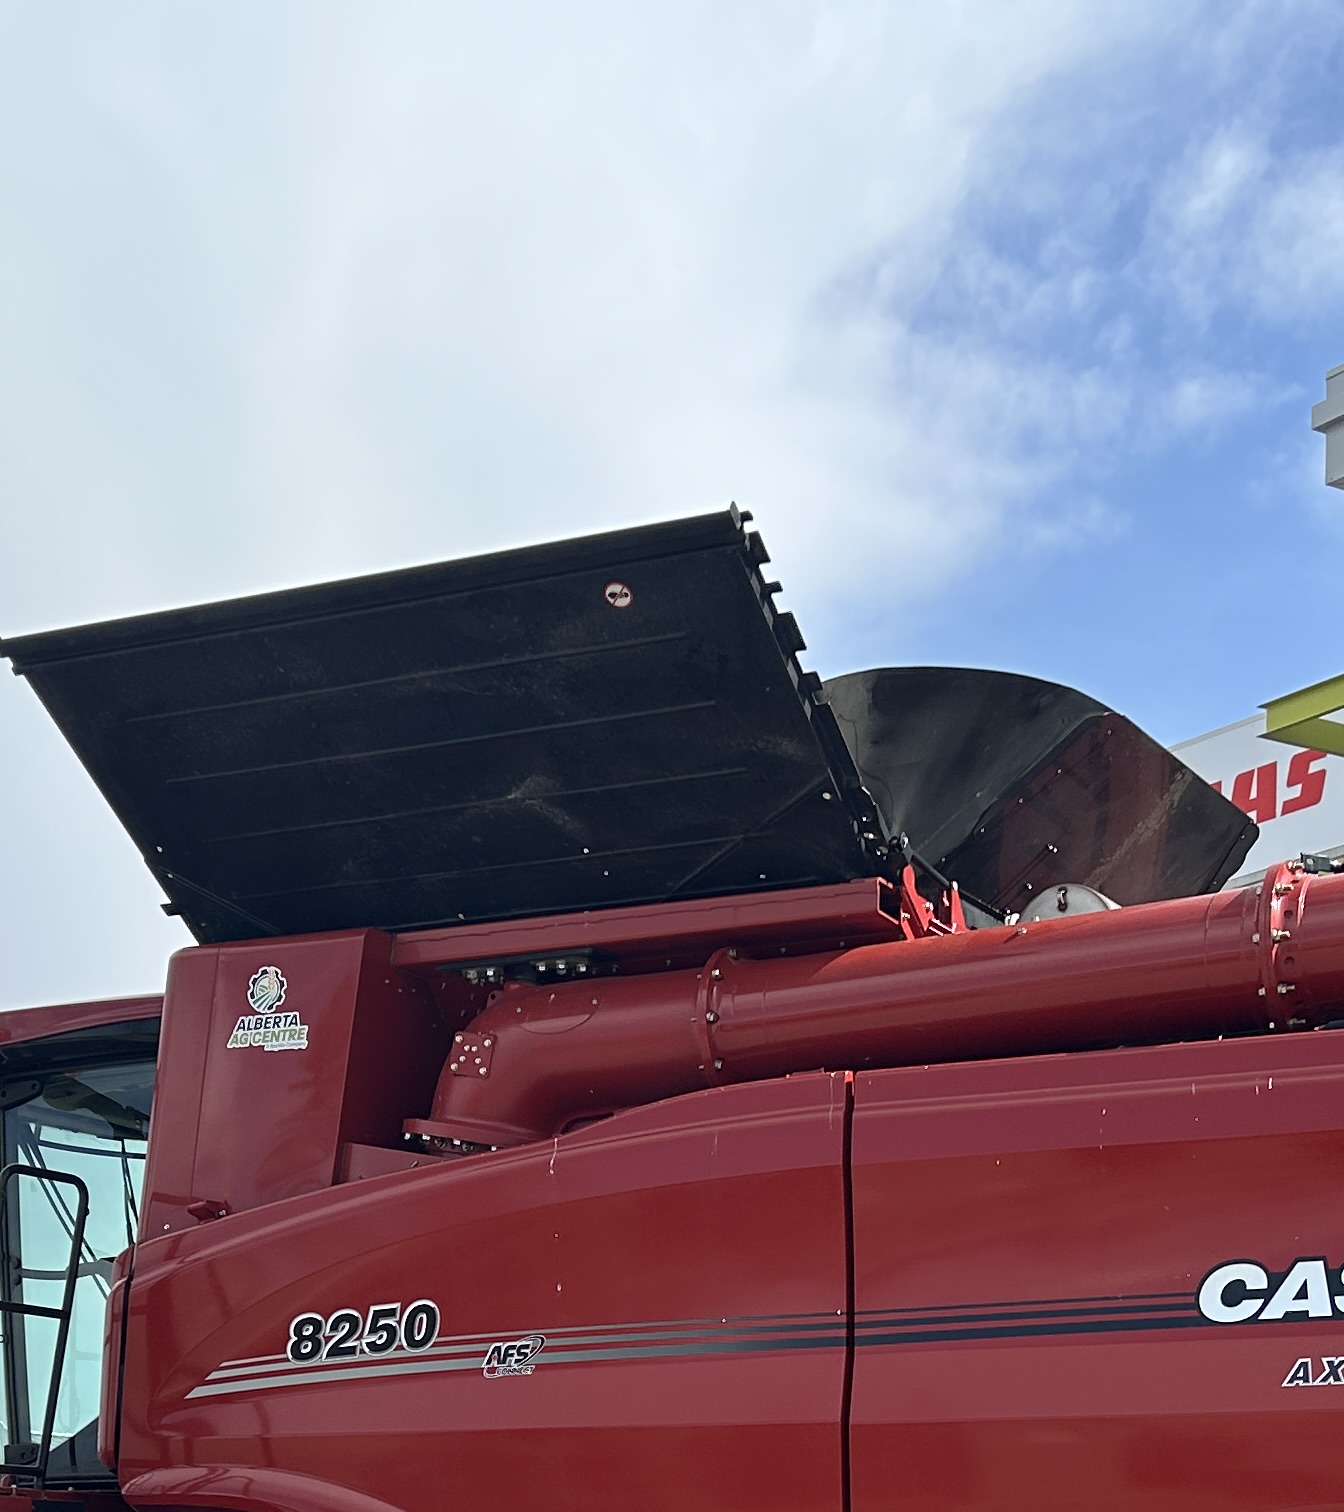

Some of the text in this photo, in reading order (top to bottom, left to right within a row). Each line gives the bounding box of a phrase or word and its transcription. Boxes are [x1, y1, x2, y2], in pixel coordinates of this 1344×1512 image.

[1209, 748, 1328, 825] AS
[236, 1014, 298, 1032] ALBERTA
[230, 1034, 249, 1046] AG
[253, 1028, 306, 1044] CENTRE
[287, 1299, 440, 1364] 8250
[484, 1342, 532, 1366] AFS
